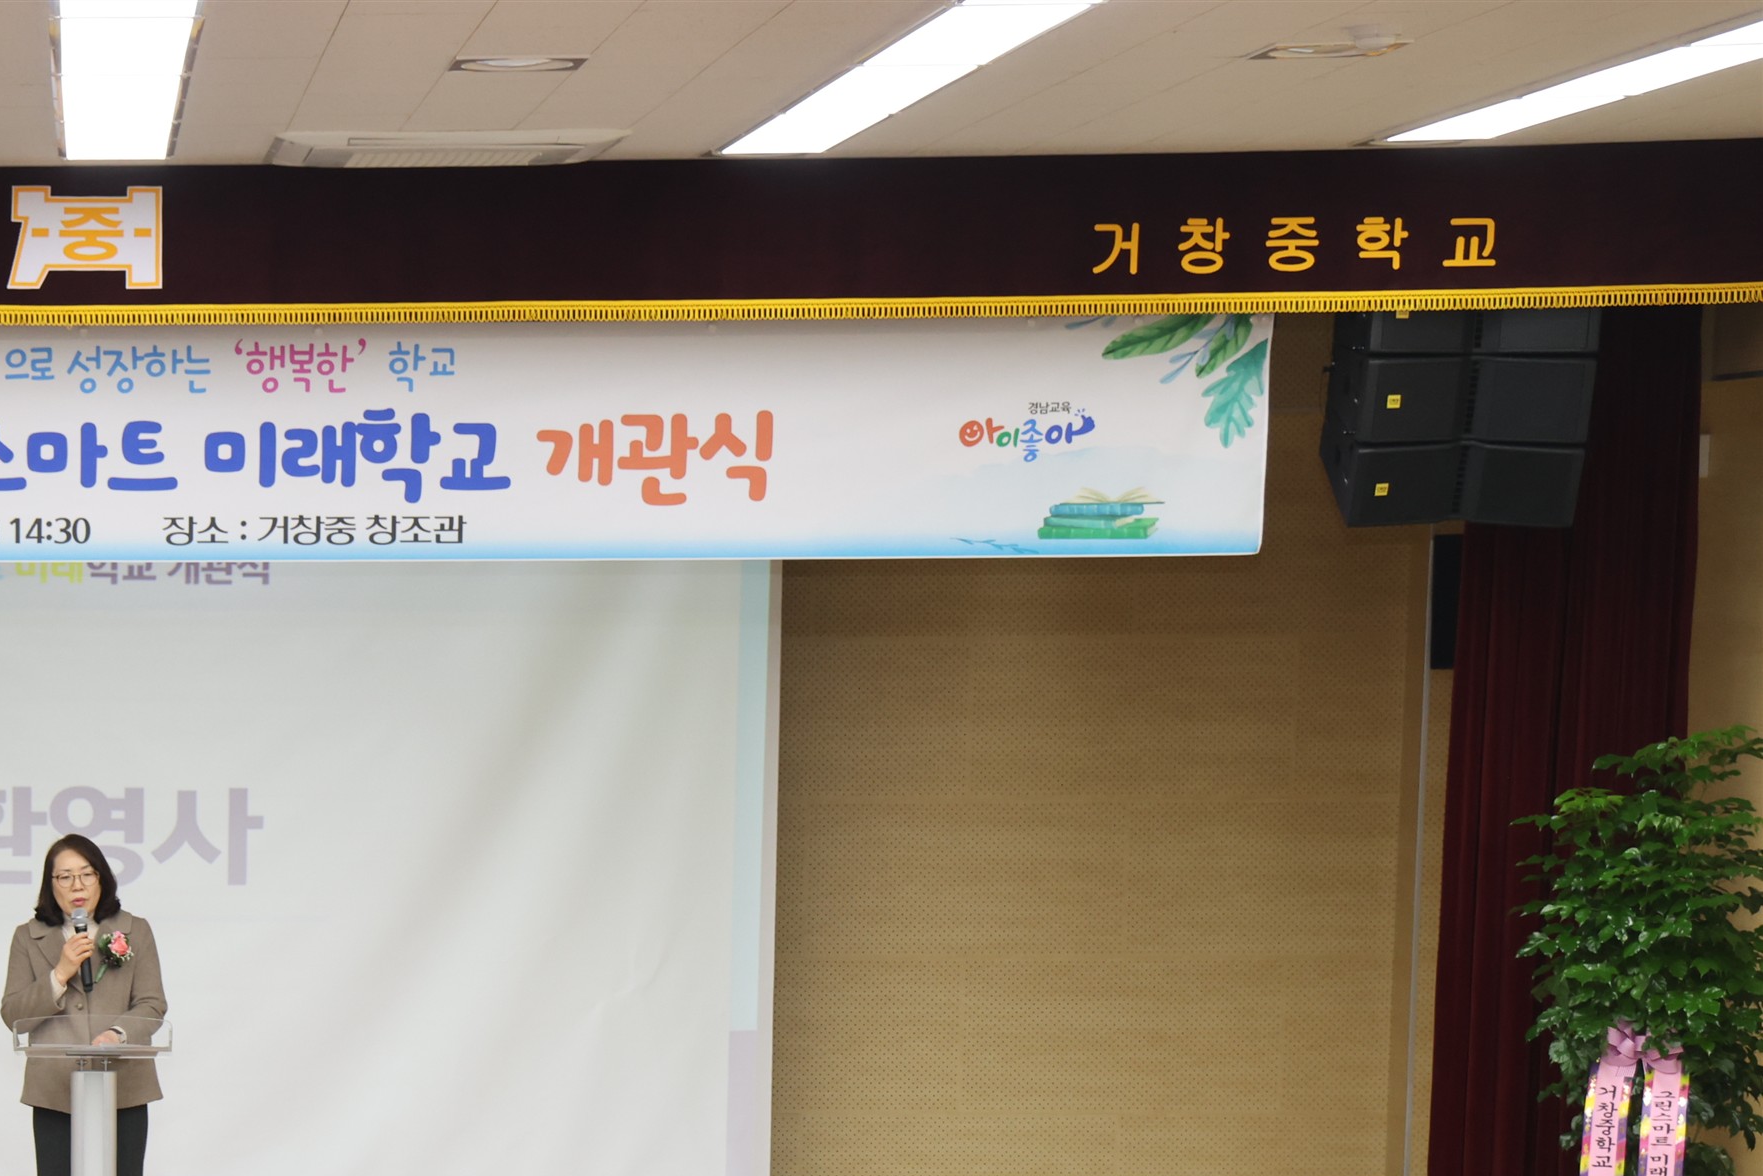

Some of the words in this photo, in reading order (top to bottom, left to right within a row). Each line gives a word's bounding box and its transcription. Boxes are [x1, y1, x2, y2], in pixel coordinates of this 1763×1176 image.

[66, 344, 211, 394] 성장하는
[388, 340, 456, 393] 학교
[1027, 401, 1072, 415] 경남교육
[203, 408, 512, 505] 미래학교
[535, 409, 774, 506] 개관식
[958, 416, 1096, 463] 아이좋아
[9, 516, 91, 546] 14:30
[161, 515, 230, 547] 장소
[256, 514, 358, 547] 거창중
[365, 514, 468, 546] 창조관
[1592, 1085, 1618, 1168] 거창중학교
[1651, 1090, 1676, 1147] 그린스마트
